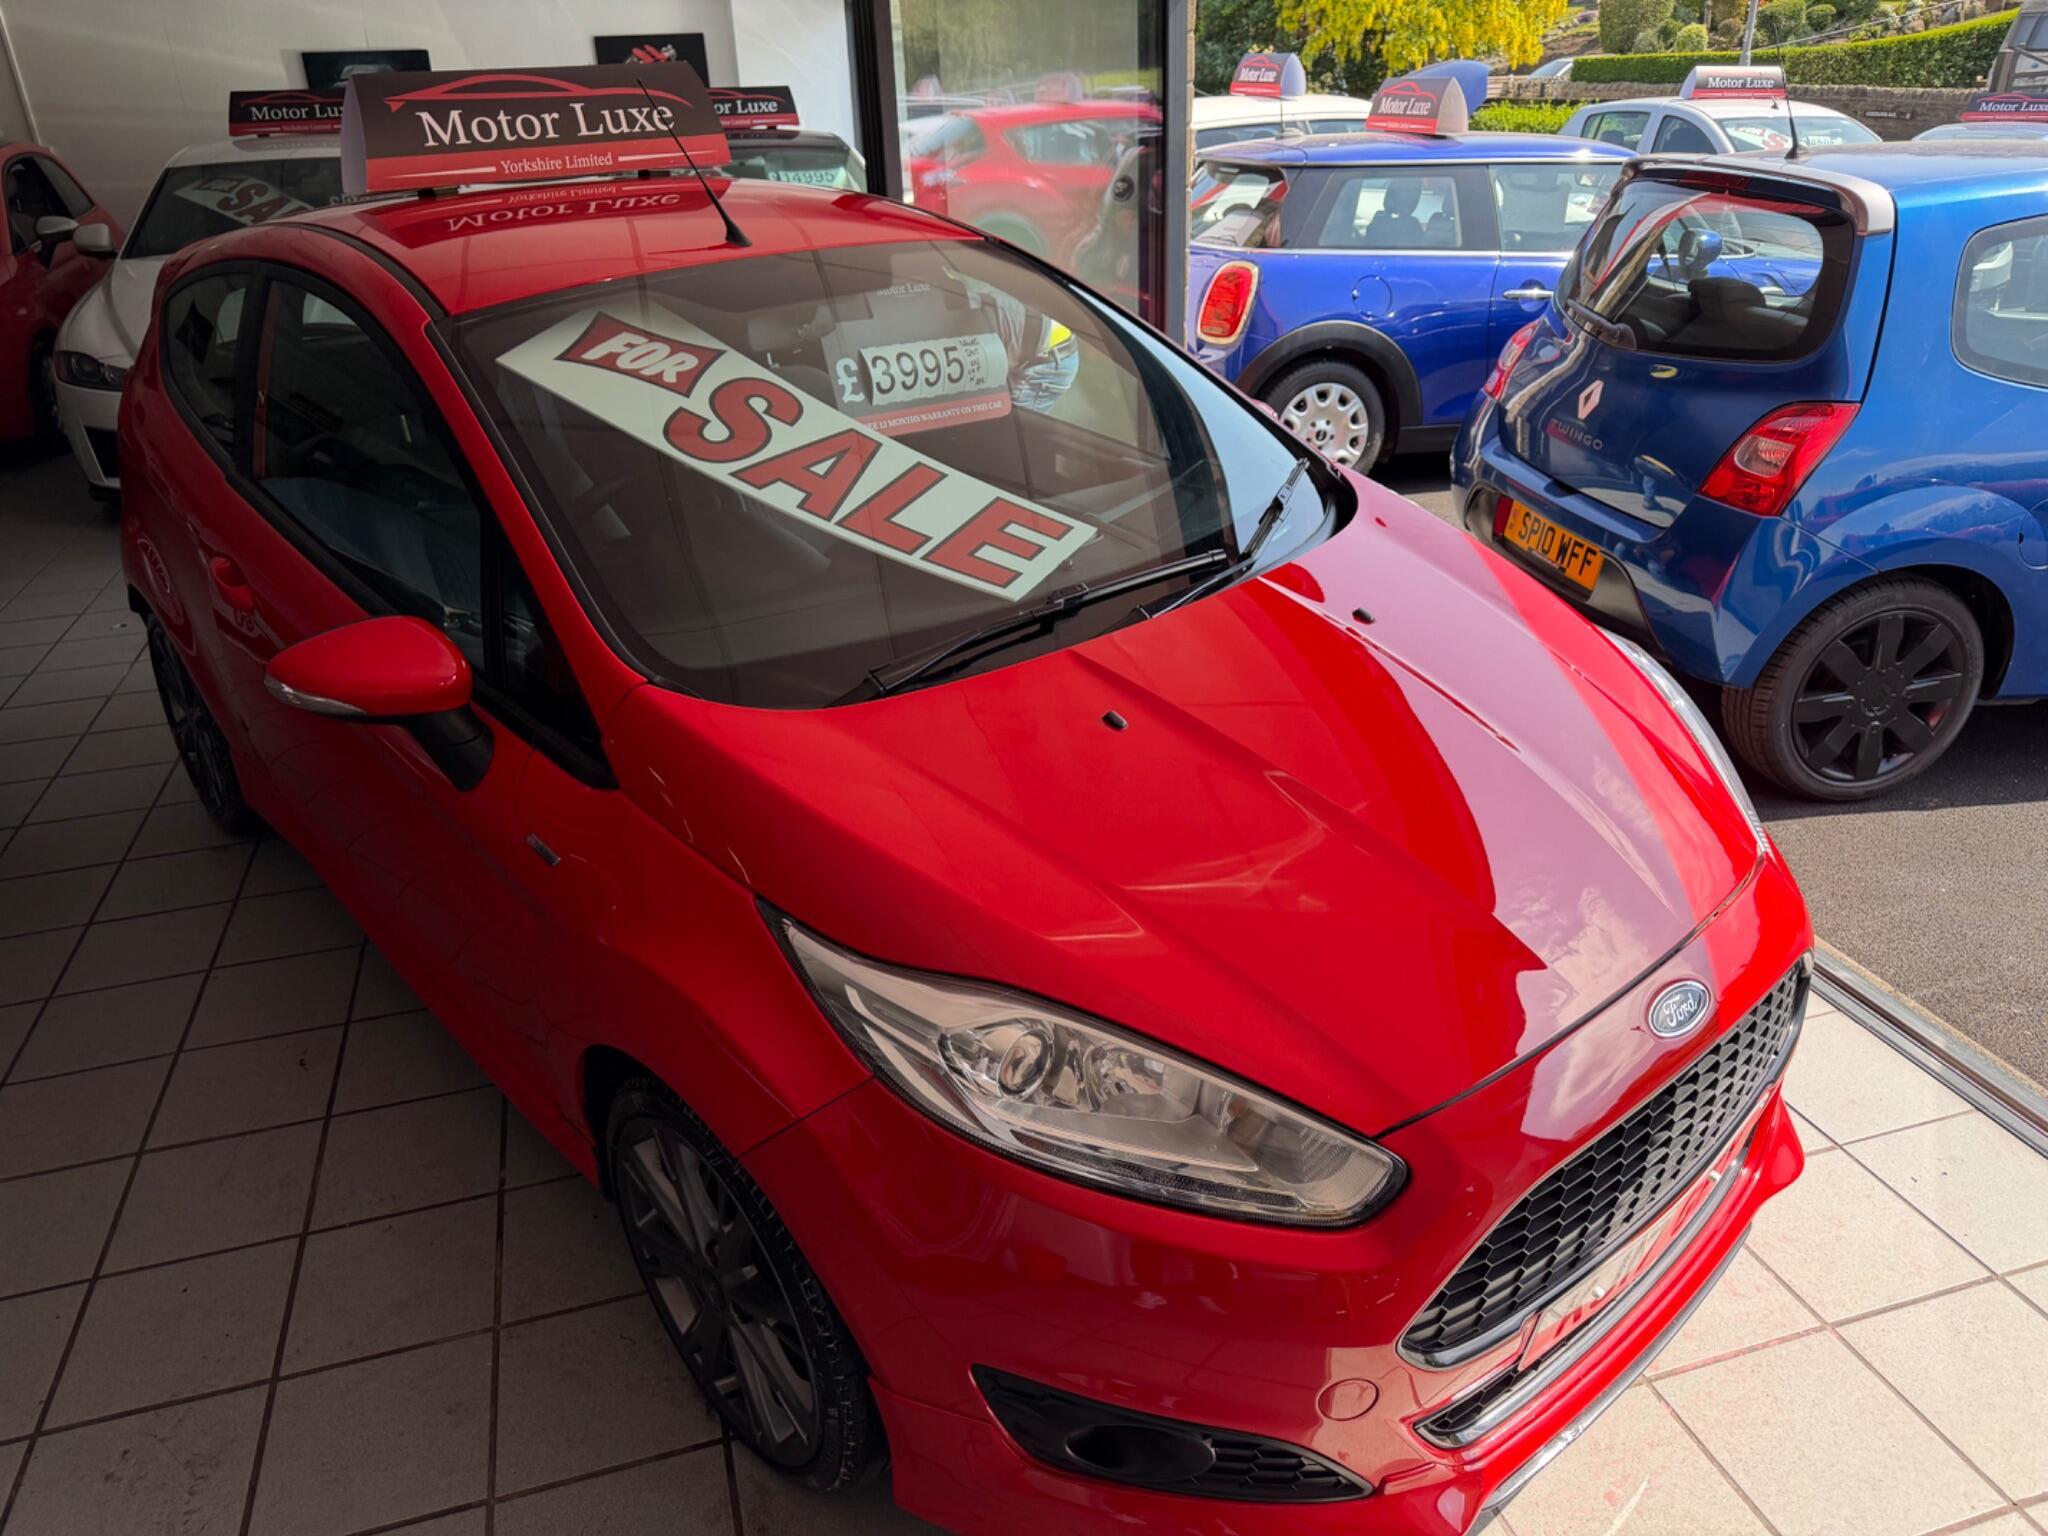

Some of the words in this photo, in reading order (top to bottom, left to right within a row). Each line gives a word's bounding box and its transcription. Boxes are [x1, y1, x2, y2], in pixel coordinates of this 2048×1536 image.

[1708, 77, 1744, 88] Motor
[1746, 77, 1774, 88] Luxe
[250, 105, 309, 121] Motor
[737, 100, 778, 113] Luxe
[1378, 97, 1408, 114] Motor
[1406, 97, 1431, 115] Luxe
[1979, 101, 2018, 111] Motor
[416, 109, 559, 146] Motor
[569, 102, 675, 137] Luxe
[500, 159, 563, 174] Yorkshire
[566, 152, 613, 169] Limited
[581, 330, 699, 383] FOR
[888, 415, 921, 427] MONTHS
[921, 408, 961, 422] WARRANTY
[1551, 418, 1604, 450] TWINGO
[663, 377, 1074, 589] SALE
[1518, 511, 1556, 555] SP10
[1555, 532, 1597, 577] WFF
[1662, 992, 1698, 1027] Ford
